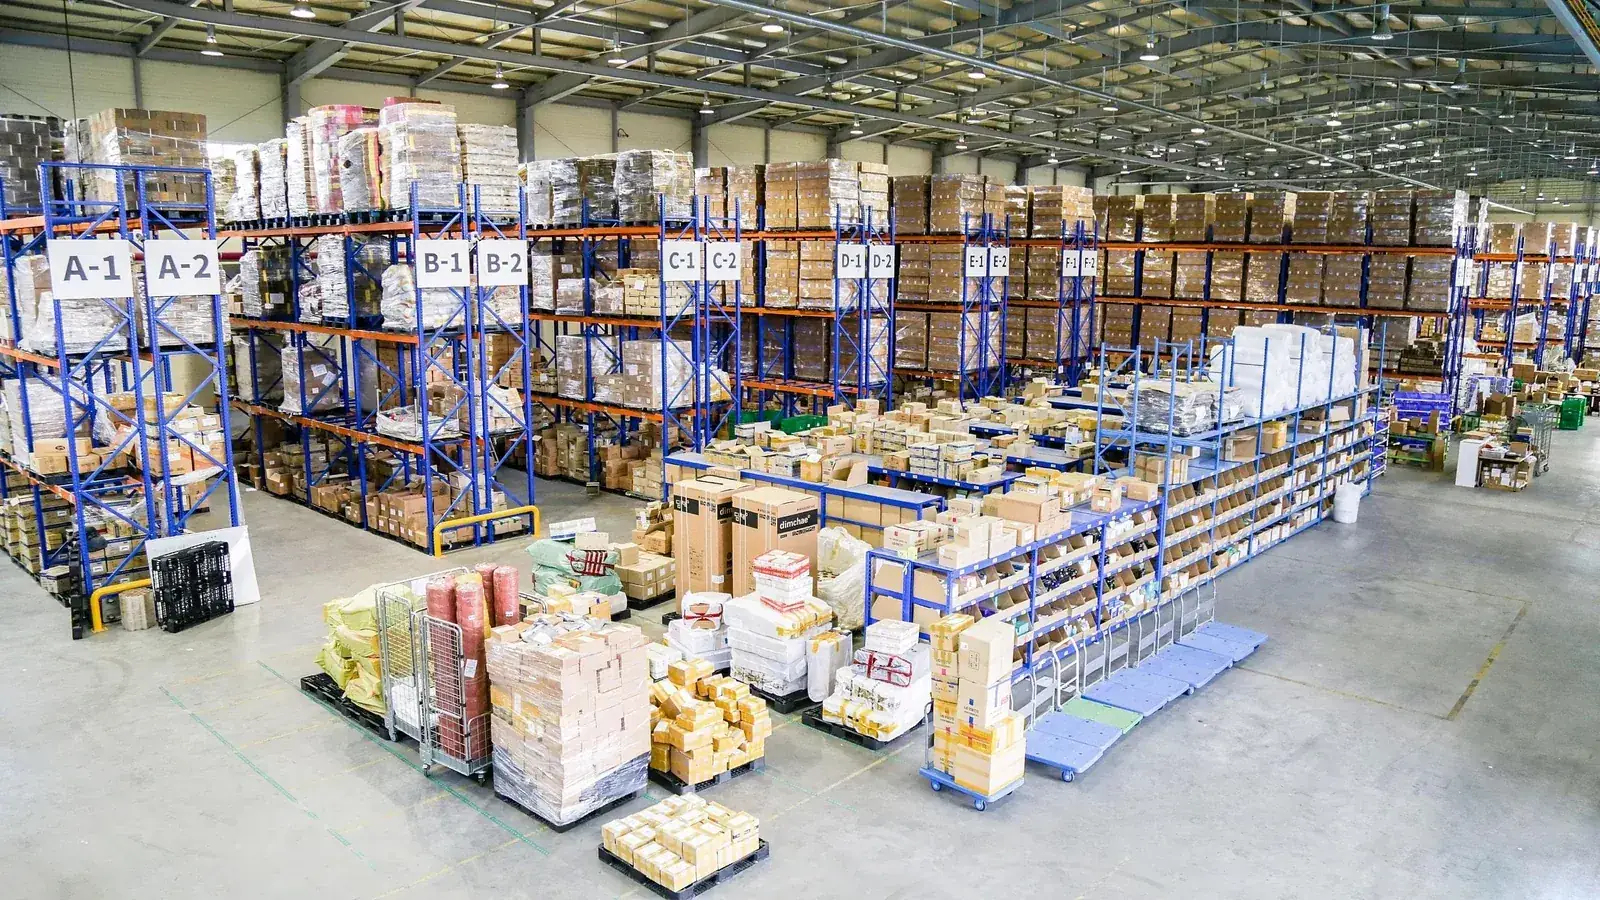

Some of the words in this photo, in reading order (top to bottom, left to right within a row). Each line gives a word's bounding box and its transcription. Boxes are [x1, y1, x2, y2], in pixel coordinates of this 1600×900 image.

[64, 255, 121, 281] A-1
[158, 254, 211, 279] A-2
[424, 252, 463, 273] B-1
[487, 253, 522, 273] B-2
[669, 252, 695, 269] C-1
[712, 252, 737, 269] C-2
[841, 253, 861, 268] D-1
[873, 254, 892, 268] D-2
[969, 255, 984, 267] E-1
[993, 255, 1007, 267] E-2
[1065, 258, 1077, 268] F-1
[1084, 257, 1095, 268] F-2
[779, 516, 809, 530] dimchae
